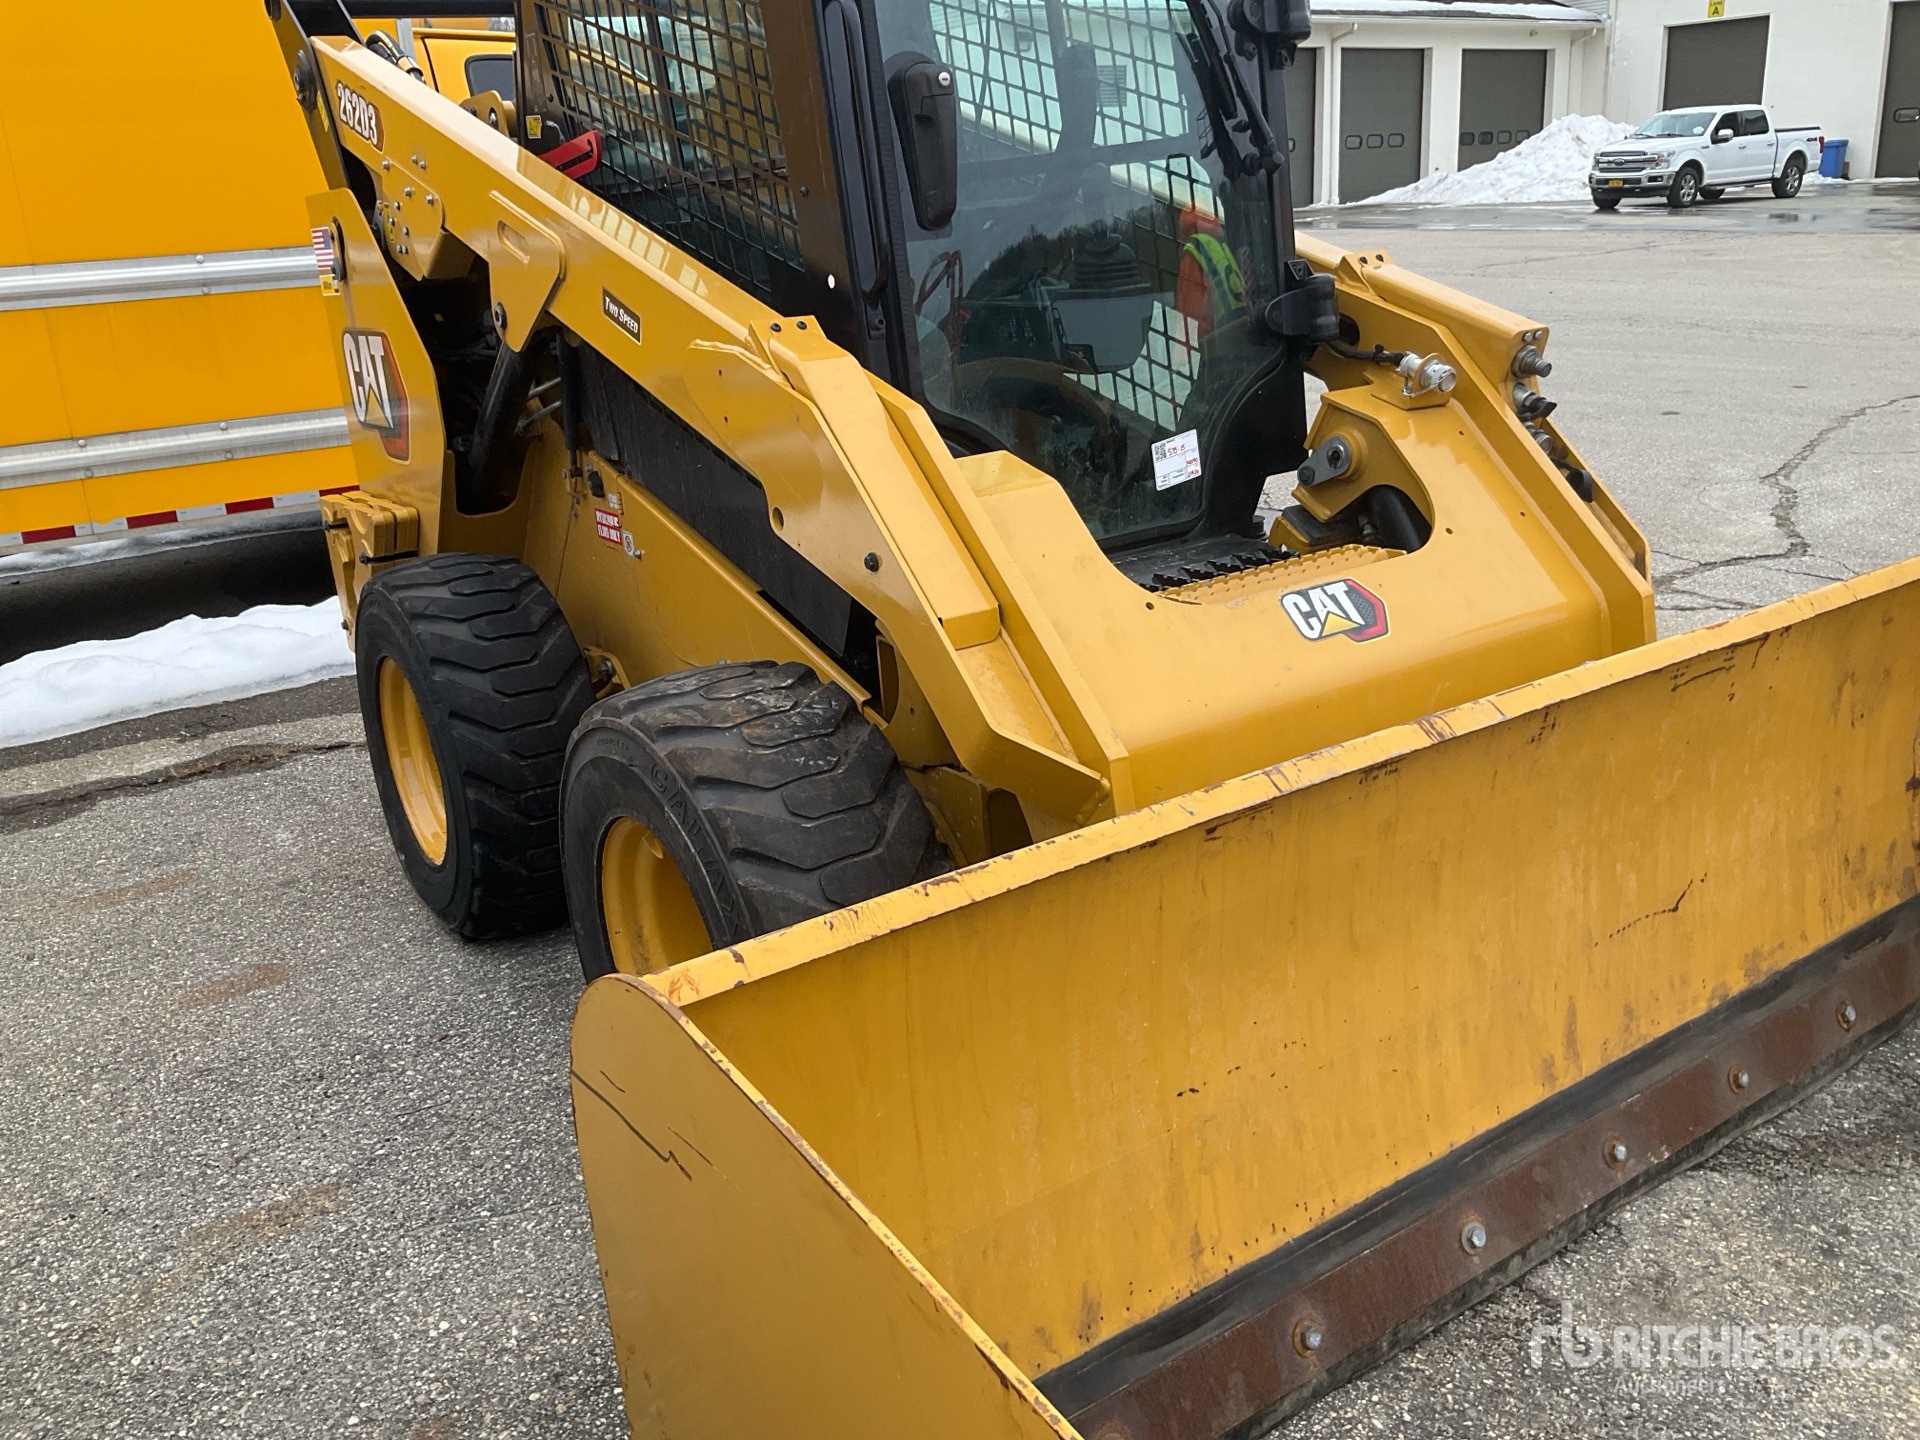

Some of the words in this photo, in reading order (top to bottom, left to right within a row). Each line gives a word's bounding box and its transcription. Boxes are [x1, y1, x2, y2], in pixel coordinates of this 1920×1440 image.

[1711, 6, 1720, 15] A
[336, 81, 379, 147] 262D3
[605, 296, 619, 318] TWO
[619, 308, 639, 334] SPEED
[343, 332, 395, 429] CAT
[1281, 581, 1366, 639] CAT
